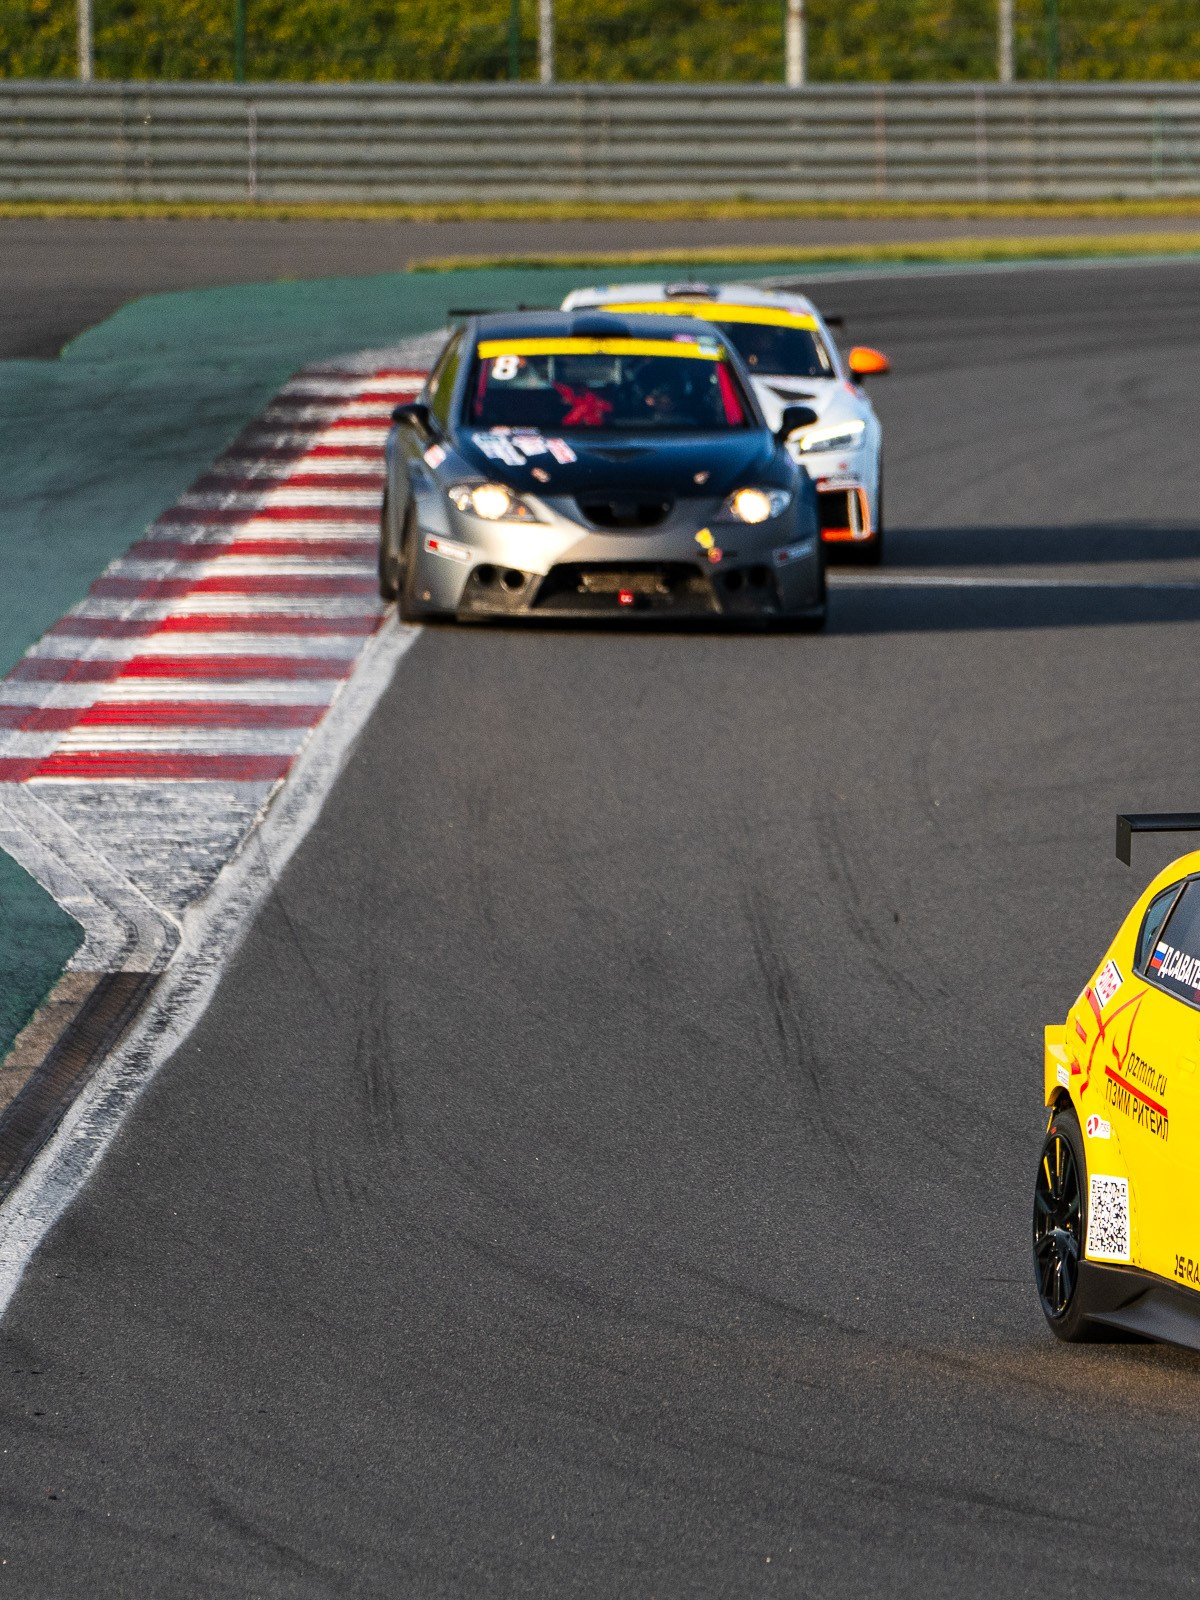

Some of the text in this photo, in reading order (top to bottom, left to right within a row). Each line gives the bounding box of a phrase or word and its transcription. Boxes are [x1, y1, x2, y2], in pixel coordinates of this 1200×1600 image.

[491, 354, 519, 380] 8
[1124, 1051, 1168, 1097] pzmm.ru
[1105, 1077, 1132, 1117] ПЗММ
